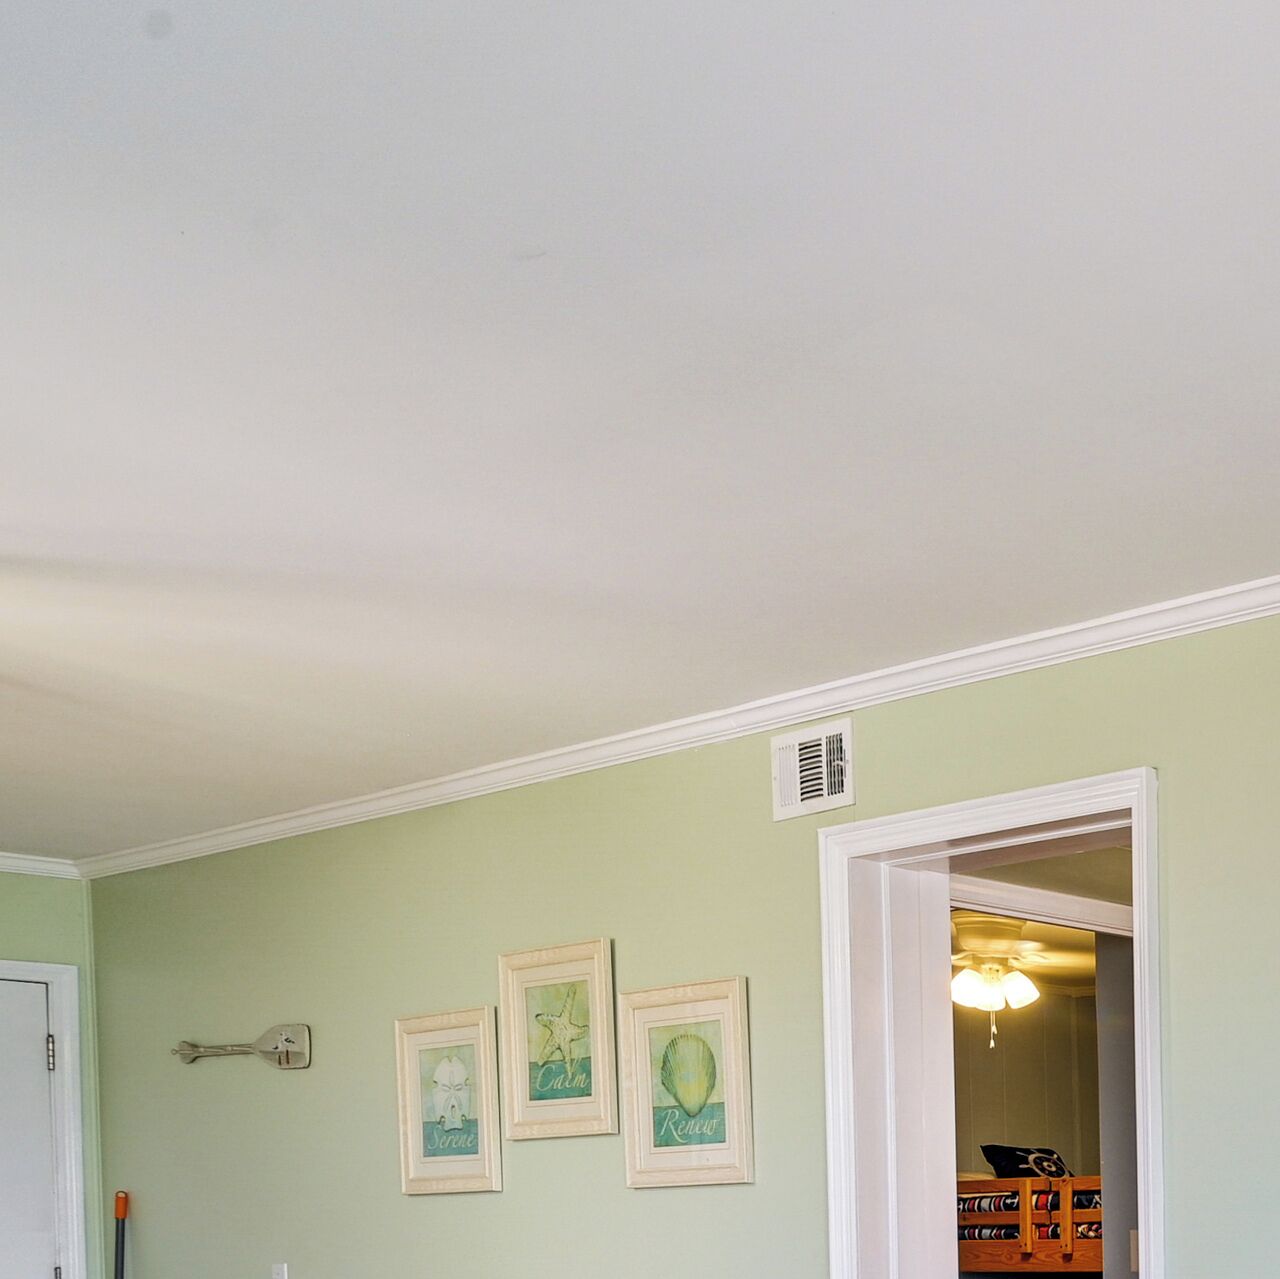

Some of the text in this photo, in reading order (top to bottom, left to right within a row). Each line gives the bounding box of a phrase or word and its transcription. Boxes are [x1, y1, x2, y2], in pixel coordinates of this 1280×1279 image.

[536, 1058, 589, 1092] Calm
[427, 1125, 475, 1150] Serene
[660, 1109, 720, 1144] Renew
